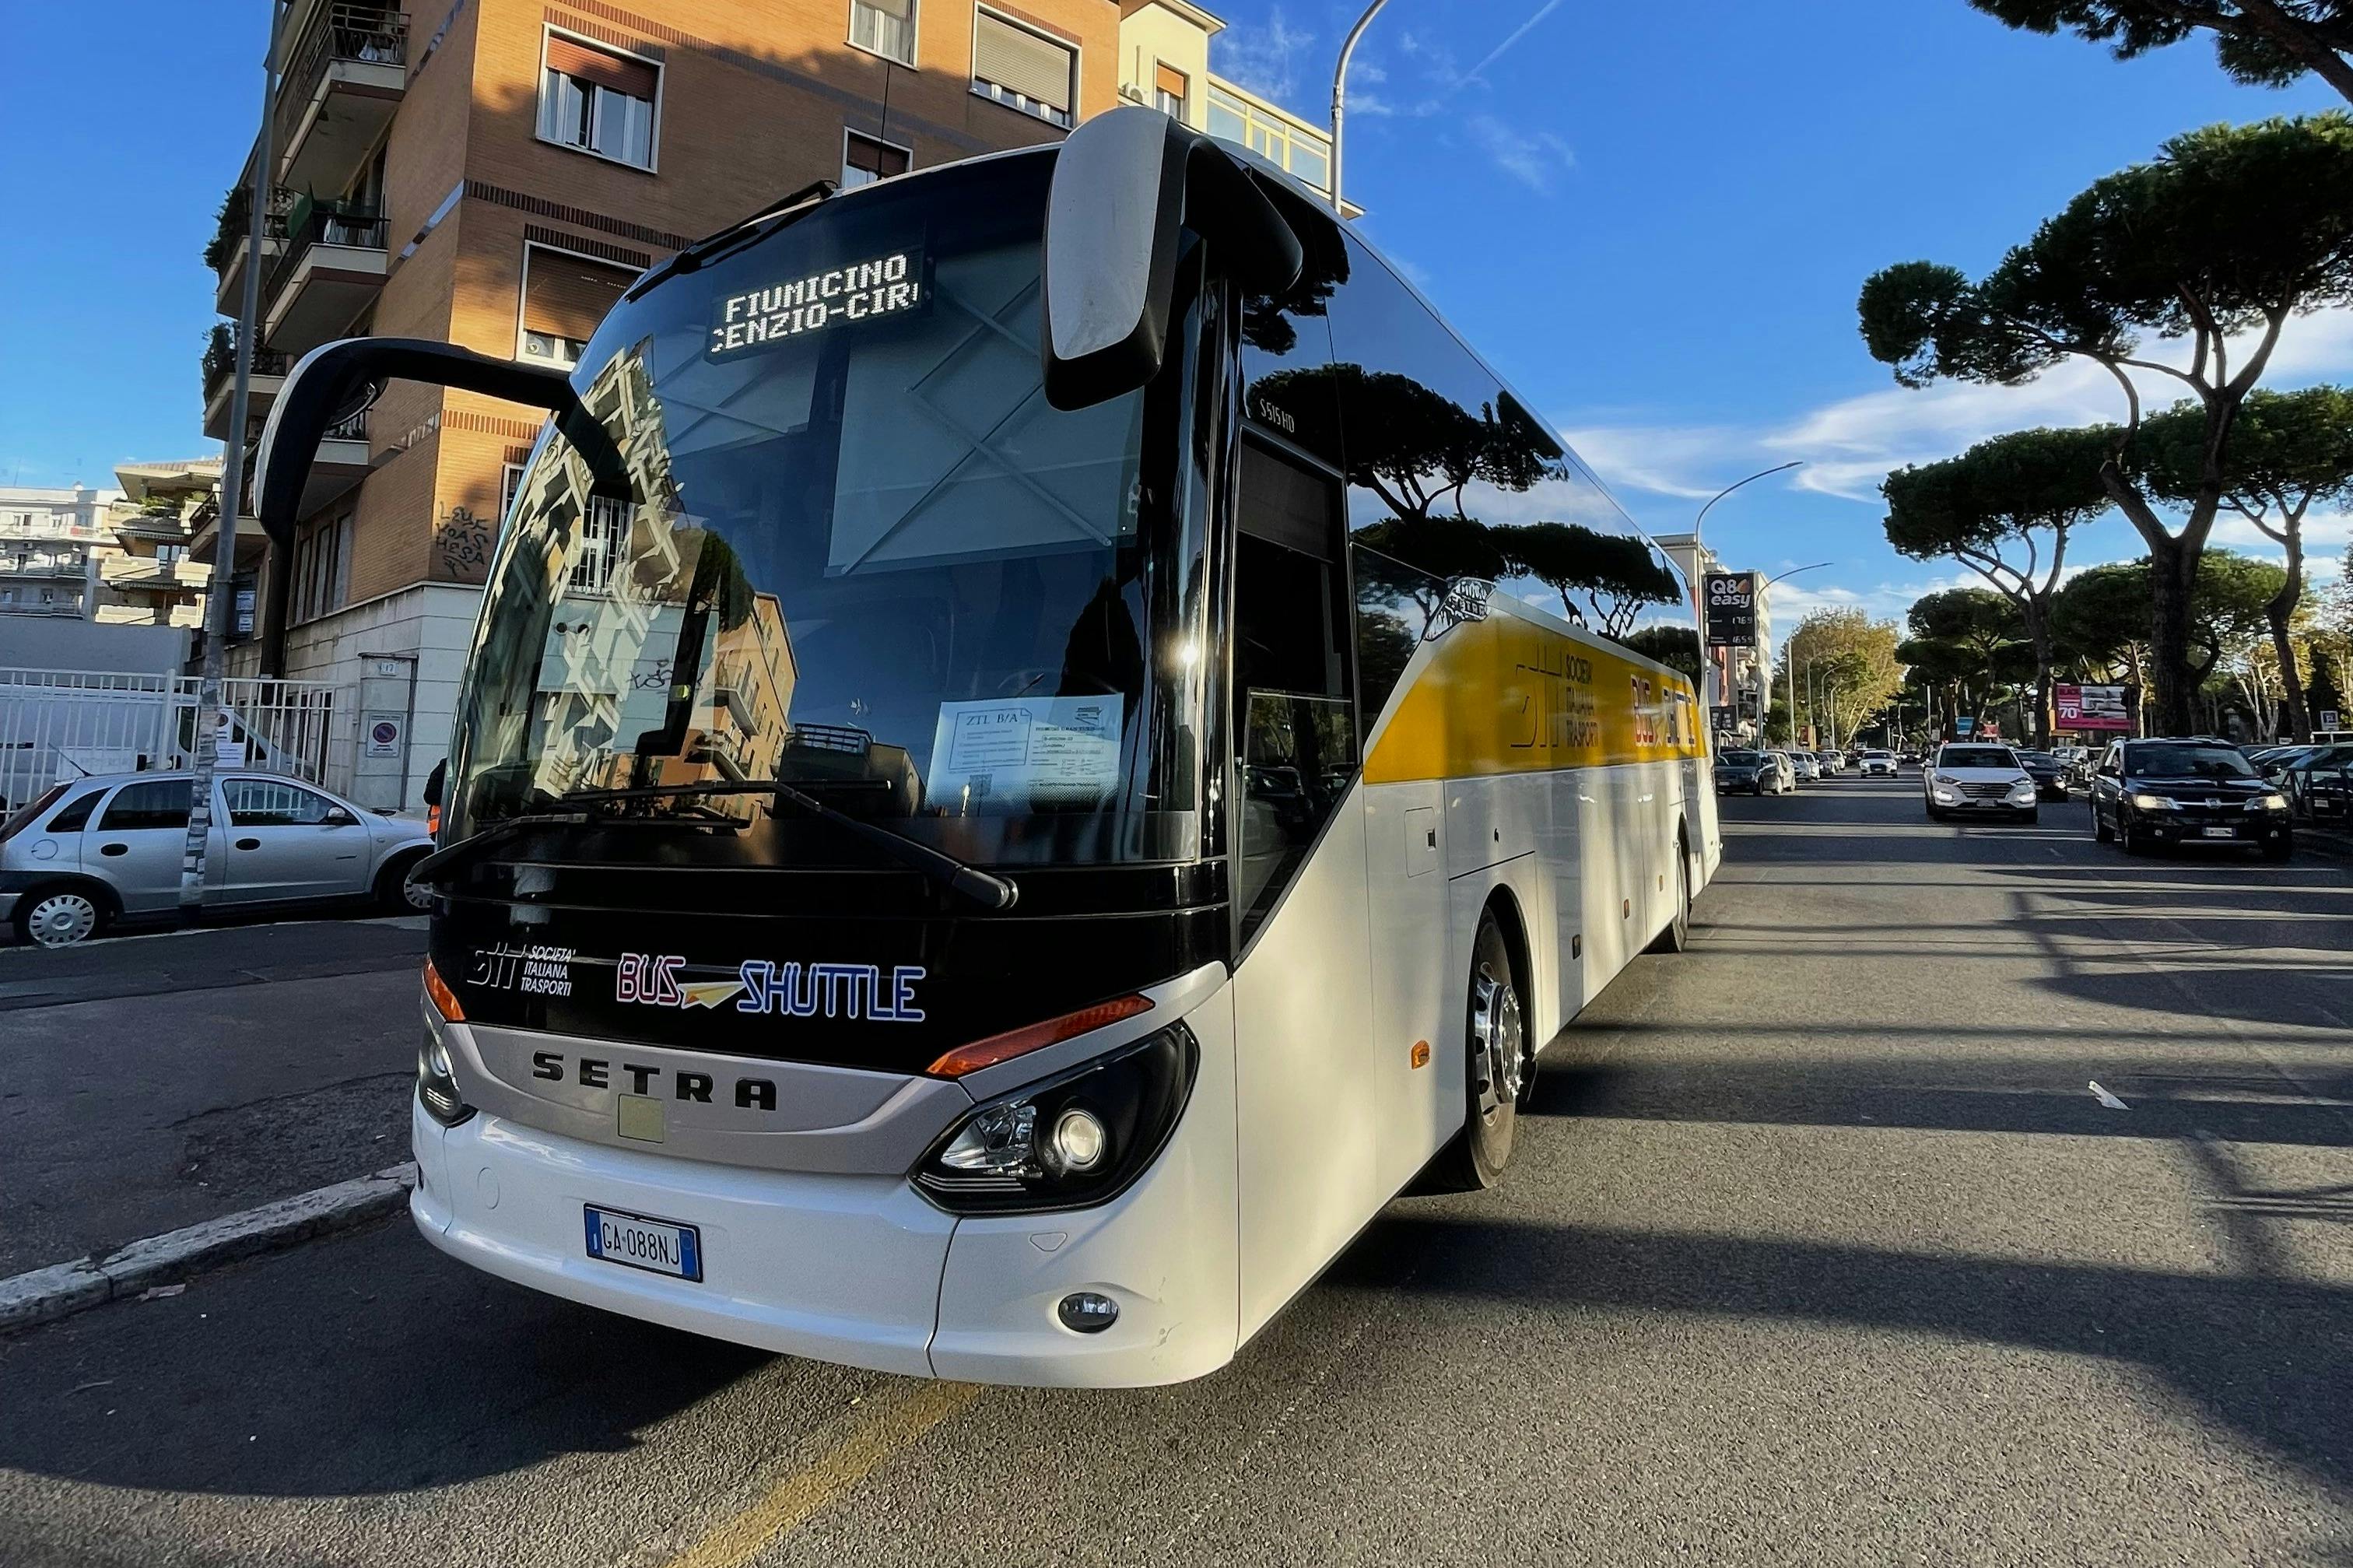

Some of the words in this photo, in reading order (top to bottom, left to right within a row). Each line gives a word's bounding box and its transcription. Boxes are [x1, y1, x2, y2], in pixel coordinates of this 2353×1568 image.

[725, 254, 906, 323] FIUMICINO
[1710, 579, 1737, 595] Q8
[1710, 595, 1751, 609] easy
[966, 714, 990, 726] ZTL
[997, 713, 1019, 724] B/A
[524, 961, 568, 980] ITALIANA
[521, 977, 572, 997] TRASPORTI
[617, 953, 686, 1005] BUS
[737, 959, 927, 1023] SHUTTLE
[532, 1050, 777, 1111] SETRA
